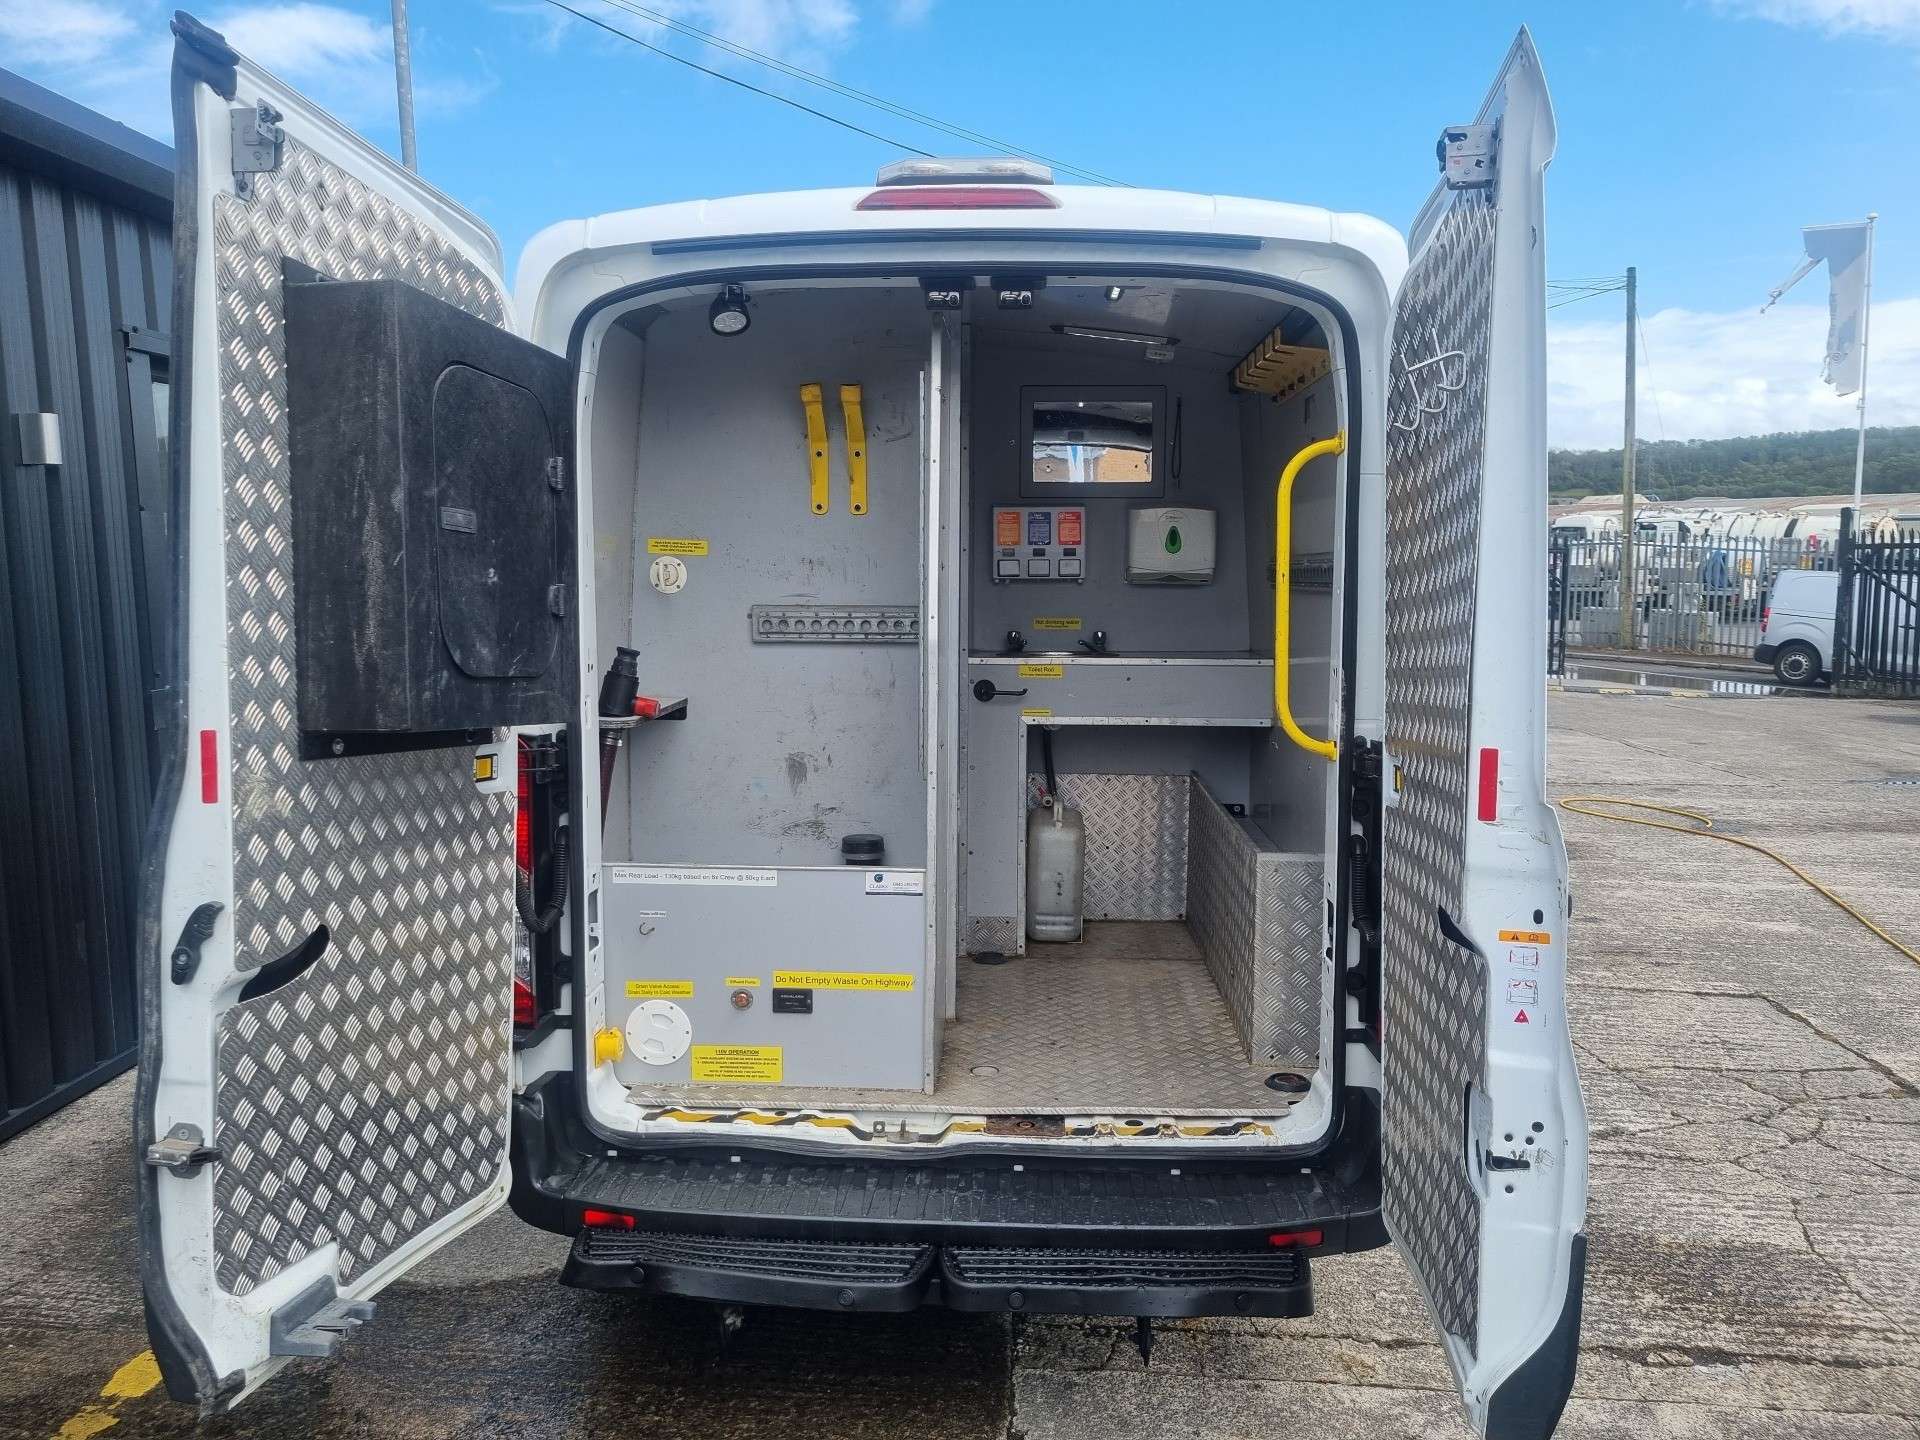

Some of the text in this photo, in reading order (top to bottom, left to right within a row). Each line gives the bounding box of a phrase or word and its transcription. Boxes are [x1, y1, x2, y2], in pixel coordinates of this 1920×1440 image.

[775, 975, 914, 990] Do Not Empty Waste On Highway
